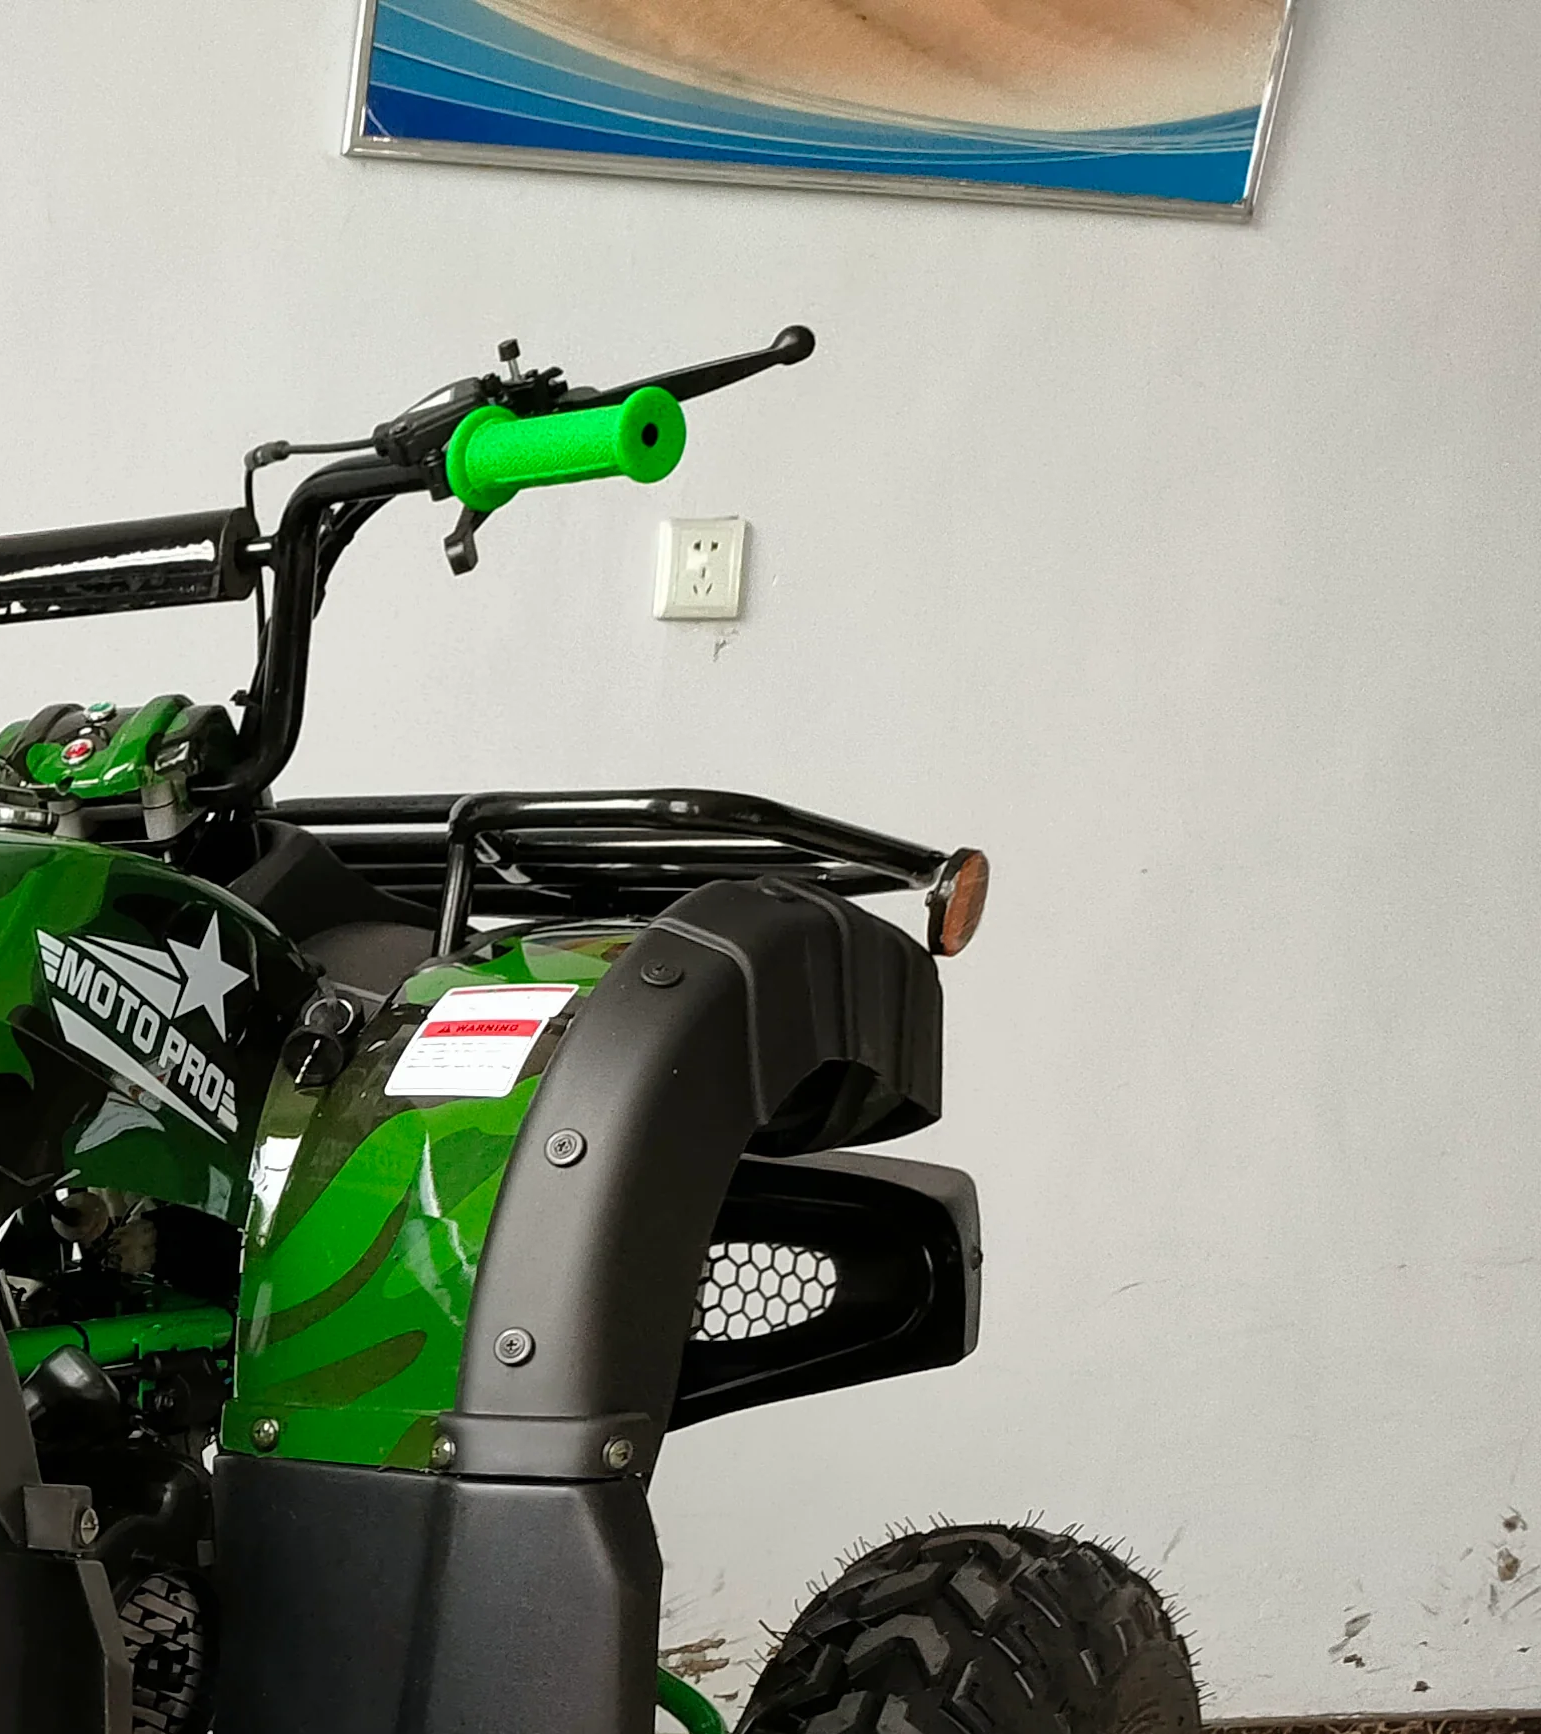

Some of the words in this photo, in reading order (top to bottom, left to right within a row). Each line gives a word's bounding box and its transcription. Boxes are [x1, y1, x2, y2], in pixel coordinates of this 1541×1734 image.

[57, 946, 161, 1055] MOTO
[158, 1025, 225, 1113] PRO
[456, 1024, 520, 1033] WARNING
